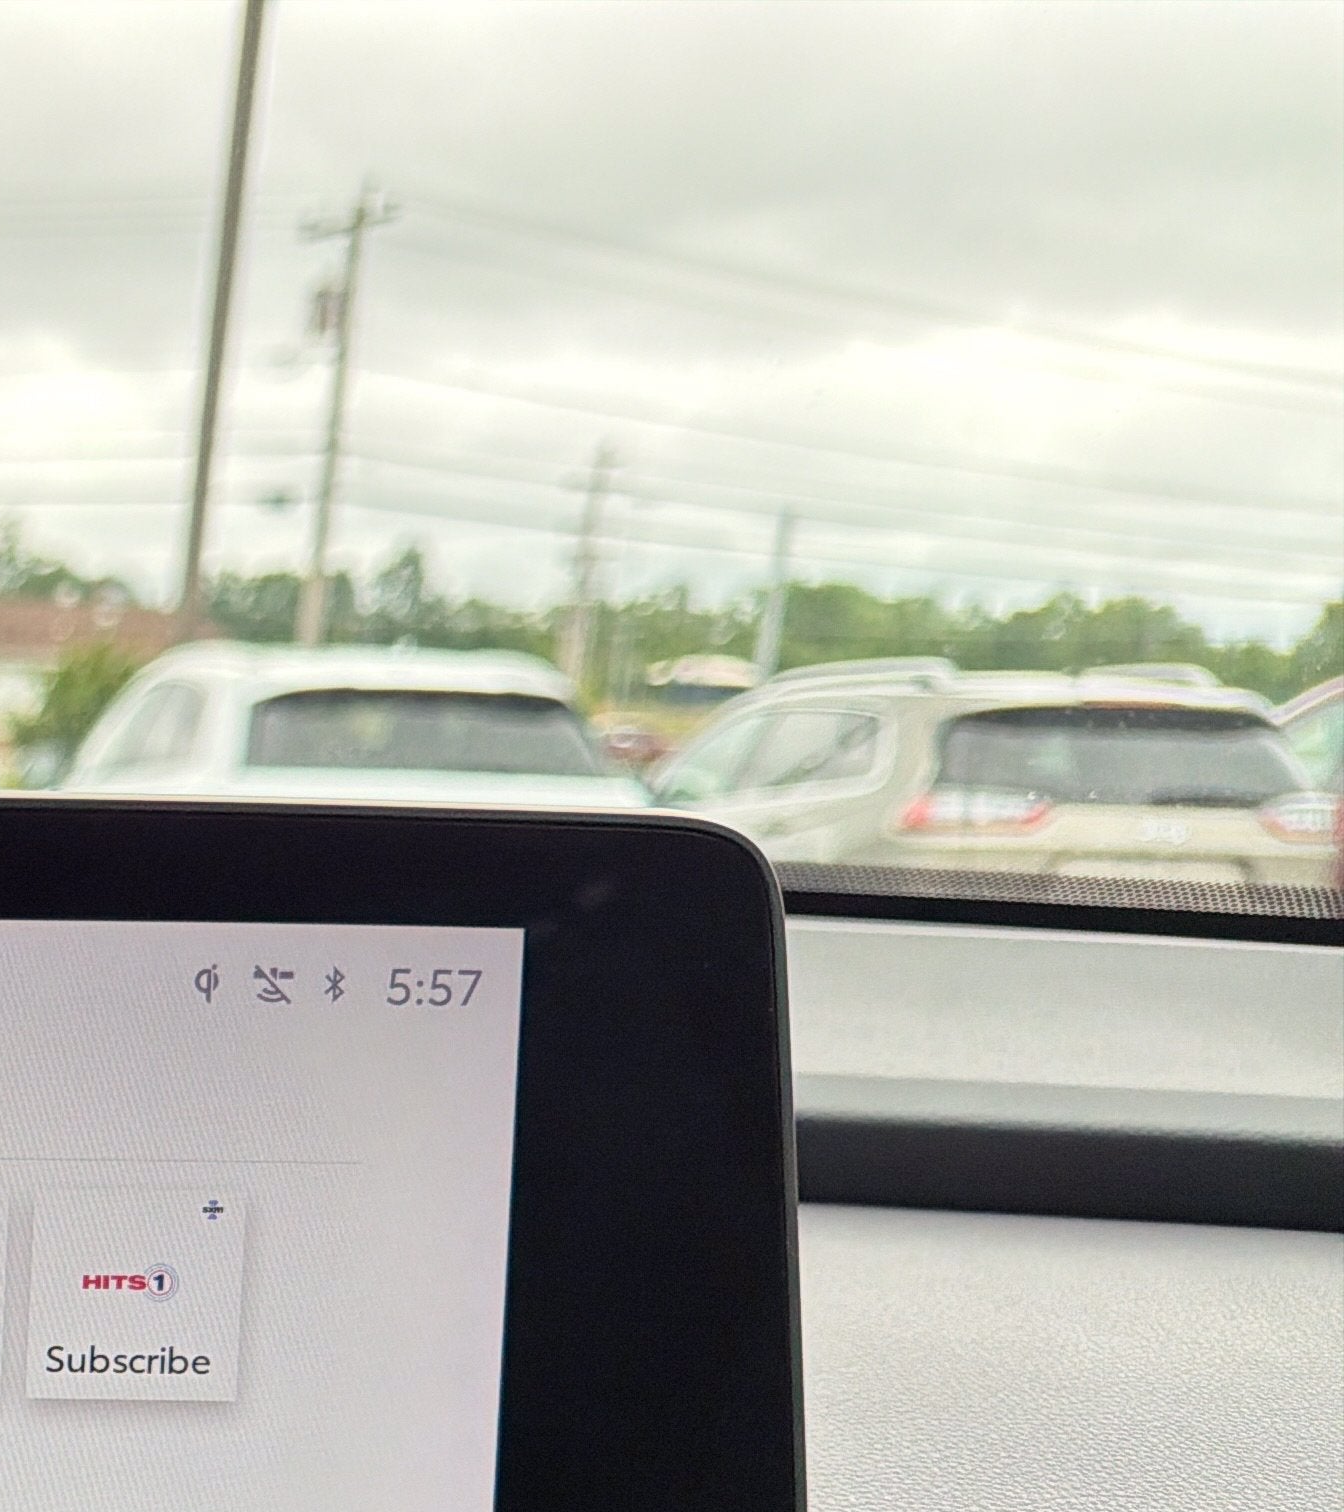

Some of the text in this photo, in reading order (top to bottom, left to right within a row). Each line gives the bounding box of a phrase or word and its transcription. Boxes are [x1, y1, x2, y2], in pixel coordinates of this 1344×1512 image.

[387, 968, 482, 1006] 5:57
[80, 1272, 147, 1292] HITS
[46, 1345, 210, 1374] Subscribe
